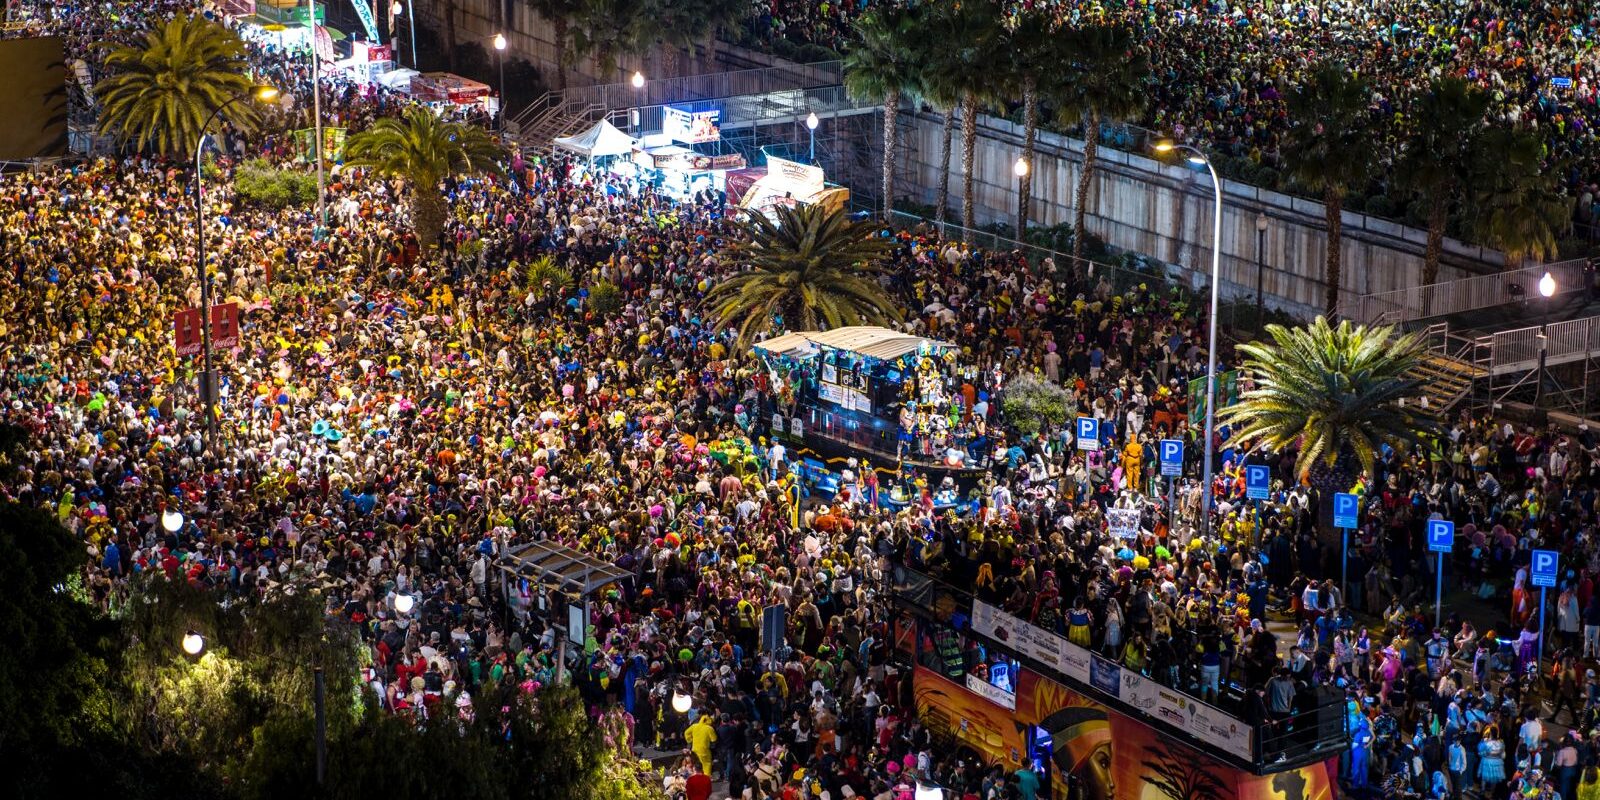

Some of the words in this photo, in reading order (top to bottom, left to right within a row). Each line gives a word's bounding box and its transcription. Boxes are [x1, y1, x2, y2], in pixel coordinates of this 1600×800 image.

[177, 342, 201, 356] Coca-Cola
[213, 336, 237, 349] Coca-Cola
[1081, 420, 1094, 437] P
[1165, 443, 1178, 460] P
[1251, 468, 1265, 485] P
[1340, 496, 1353, 514] P
[1433, 523, 1449, 541] P
[1537, 553, 1553, 572] P
